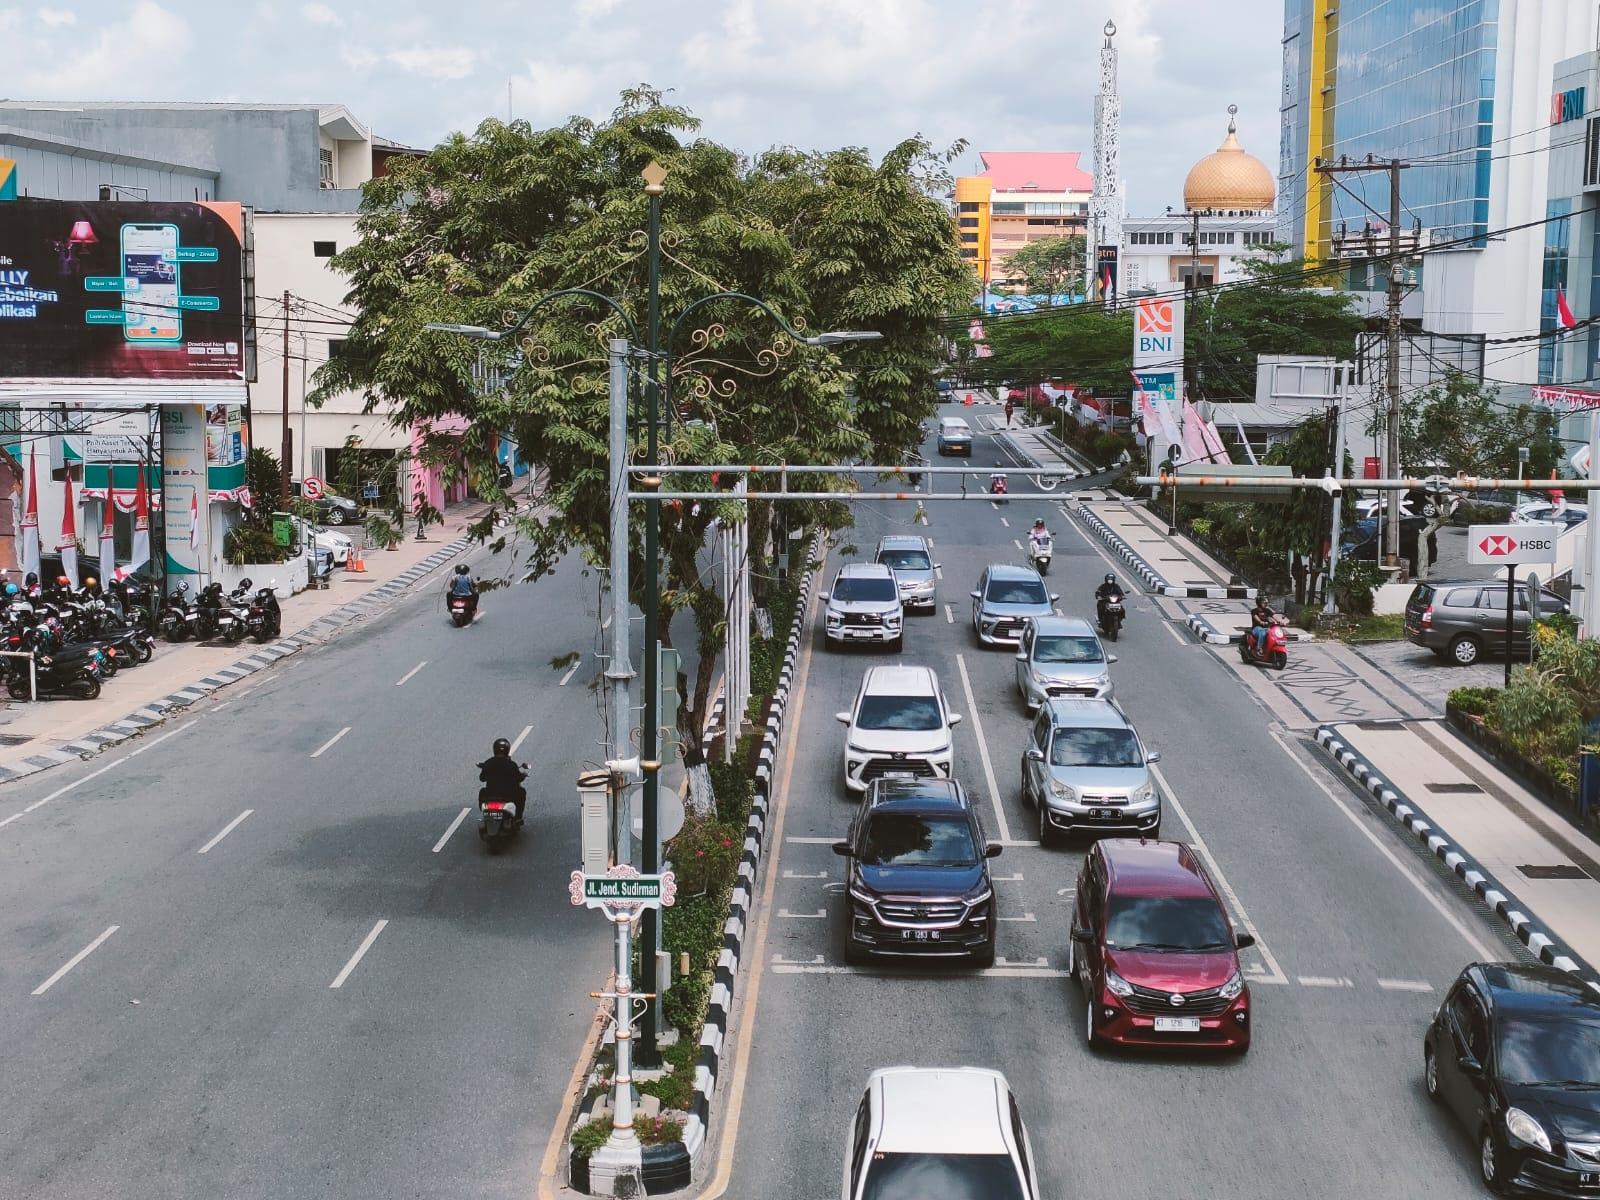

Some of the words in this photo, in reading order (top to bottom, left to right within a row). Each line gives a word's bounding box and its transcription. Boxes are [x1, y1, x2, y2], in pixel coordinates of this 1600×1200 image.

[1562, 87, 1585, 122] BNI
[1096, 249, 1116, 257] atm
[0, 255, 13, 265] ile
[1139, 337, 1172, 352] BNI
[162, 411, 184, 423] BSI
[1520, 540, 1552, 550] HSBC
[587, 882, 597, 895] Jl.
[599, 882, 619, 896] Jend.
[621, 882, 659, 896] Sudirman
[1580, 1173, 1591, 1183] KT
